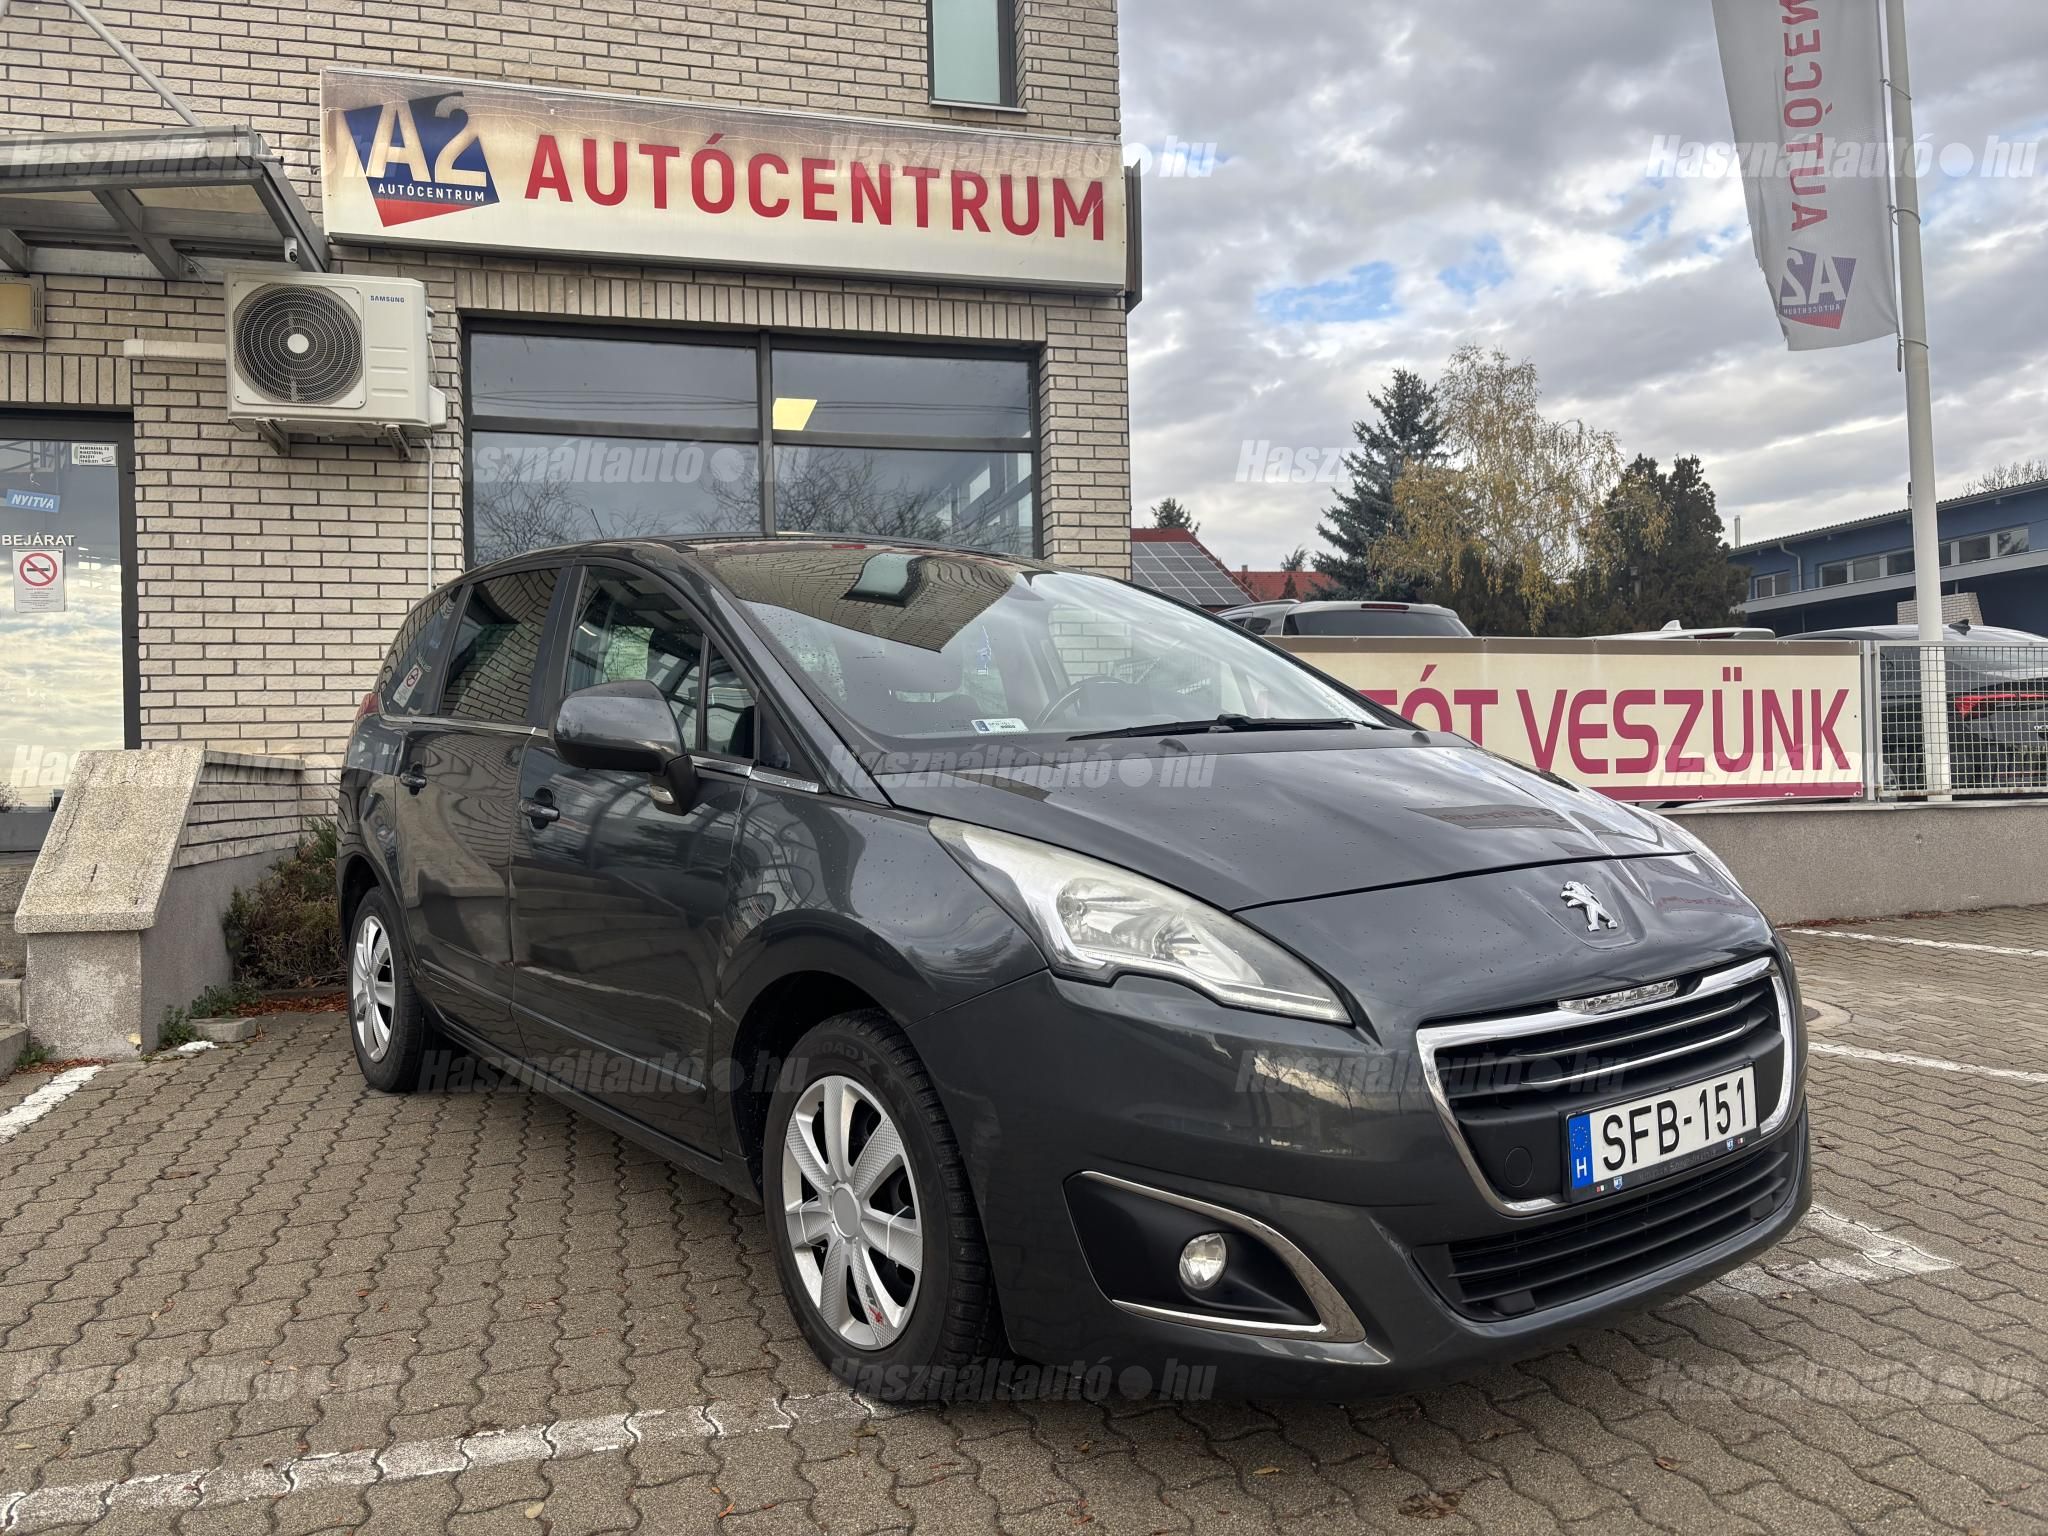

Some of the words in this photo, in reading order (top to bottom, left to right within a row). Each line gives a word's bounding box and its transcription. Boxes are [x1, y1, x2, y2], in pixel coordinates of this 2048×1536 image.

[366, 95, 487, 187] A2
[378, 183, 485, 202] AUTÓCENTRUM
[525, 133, 1105, 241] AUTÓCENTRUM
[370, 295, 405, 303] SAMSUNG
[12, 494, 55, 509] NYITVA
[2, 531, 75, 546] BEJÁRAT
[1516, 666, 1851, 774] VESZÜNK
[1593, 982, 1672, 1006] PEUGEOT
[1602, 1076, 1746, 1171] SFB-151
[1576, 1157, 1588, 1178] H
